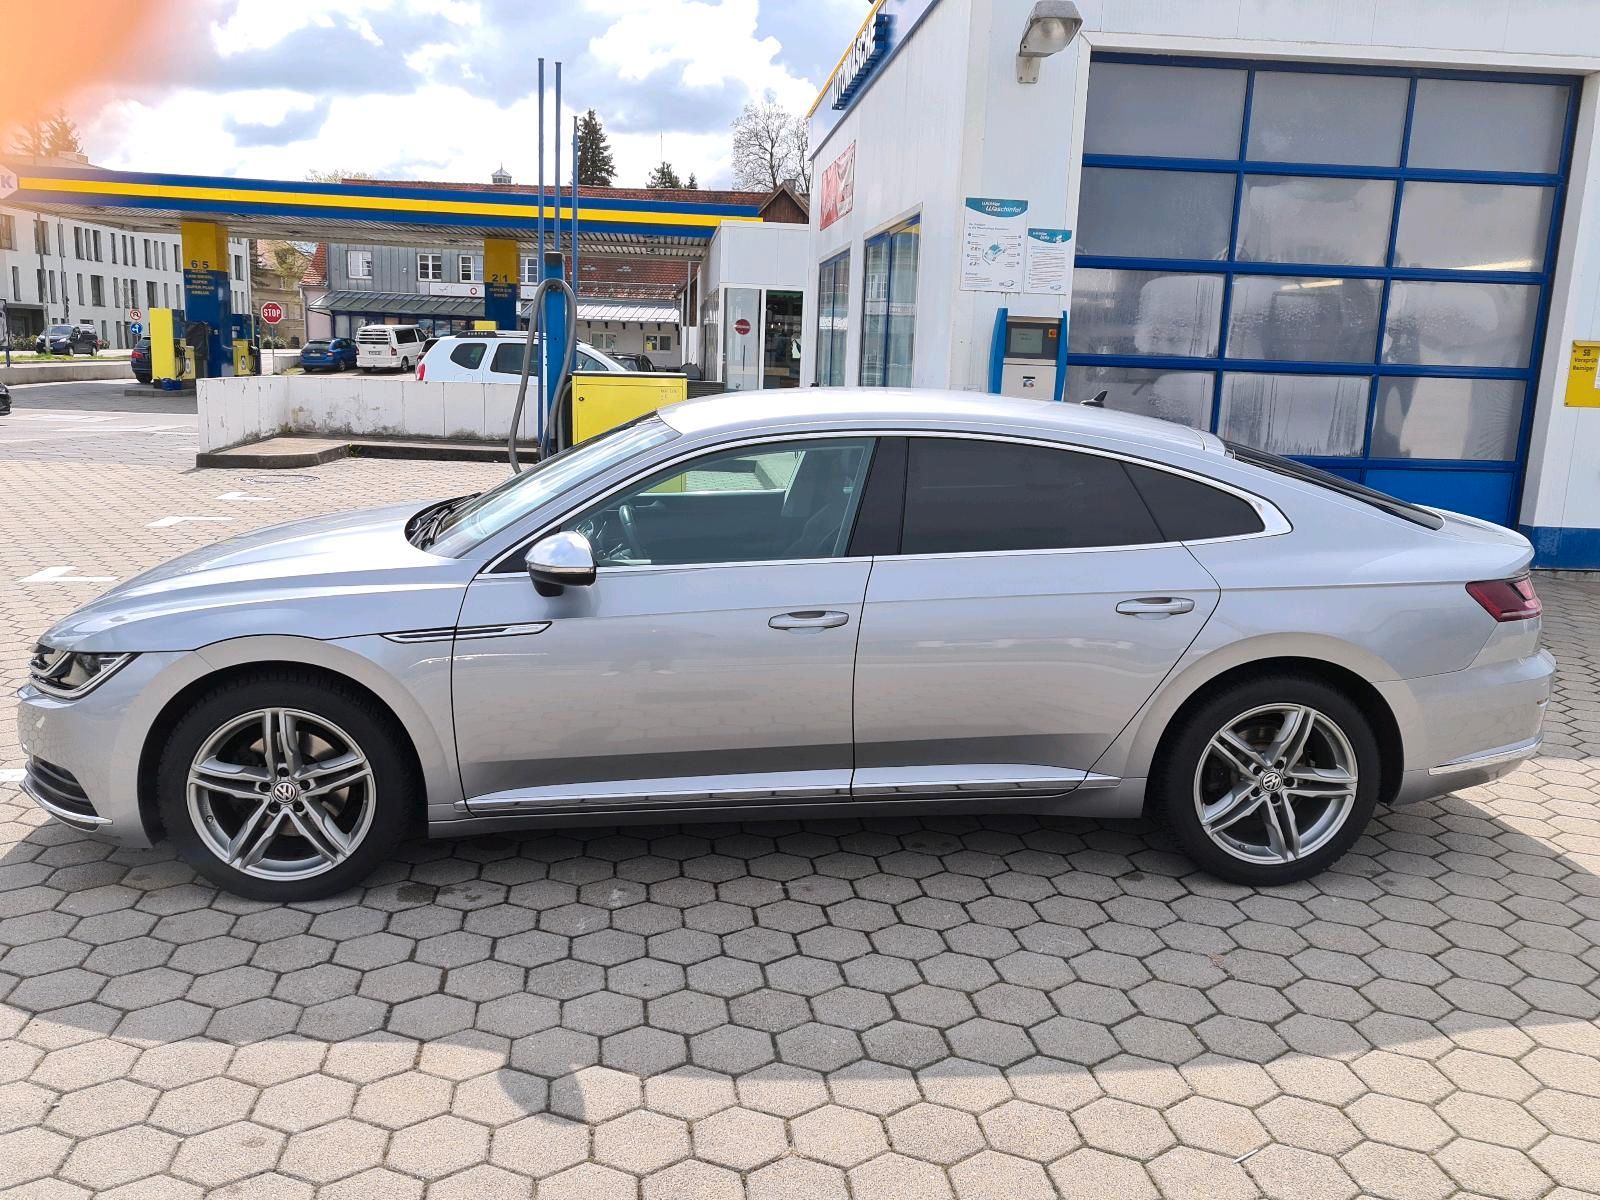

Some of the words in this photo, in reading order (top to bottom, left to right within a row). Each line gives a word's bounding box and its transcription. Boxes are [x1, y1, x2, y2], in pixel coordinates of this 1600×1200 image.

[191, 260, 198, 268] 6
[203, 261, 209, 269] 5
[263, 308, 281, 317] STOP
